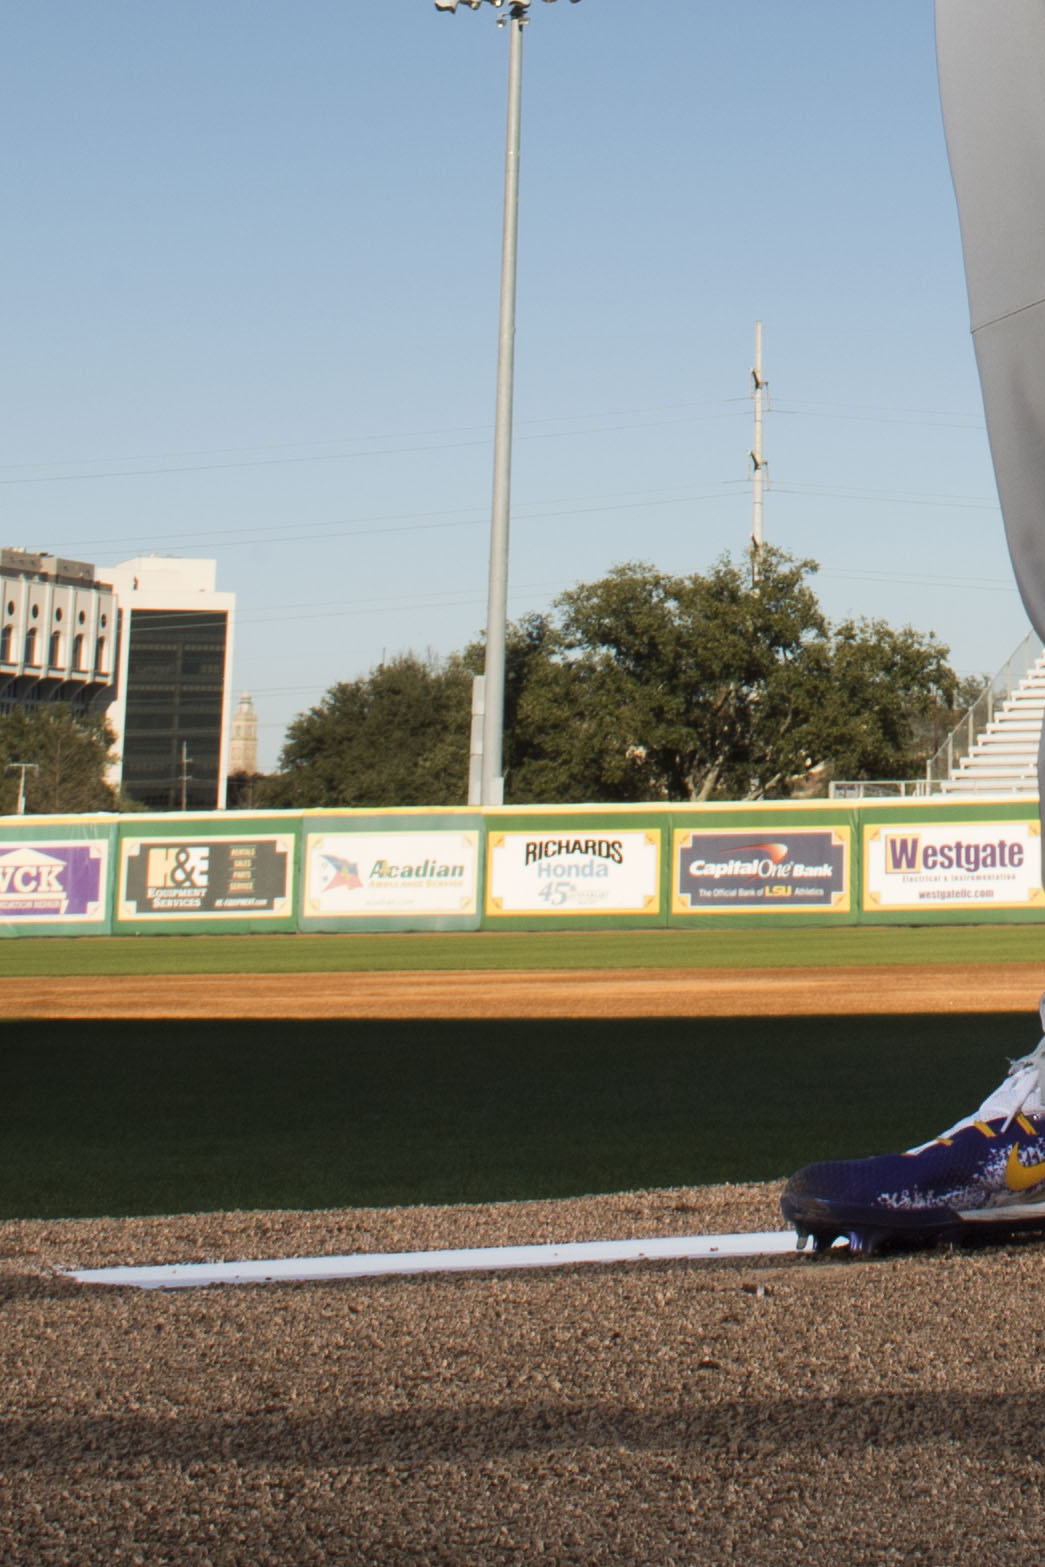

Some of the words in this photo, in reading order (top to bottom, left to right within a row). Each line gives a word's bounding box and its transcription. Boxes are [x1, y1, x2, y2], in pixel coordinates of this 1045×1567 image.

[525, 838, 623, 866] RICHARDS
[890, 837, 1024, 873] Westgate
[146, 846, 210, 888] H&E
[368, 859, 465, 879] Acadian
[538, 860, 609, 879] Honda
[793, 864, 833, 877] Bank
[765, 885, 792, 897] LSU
